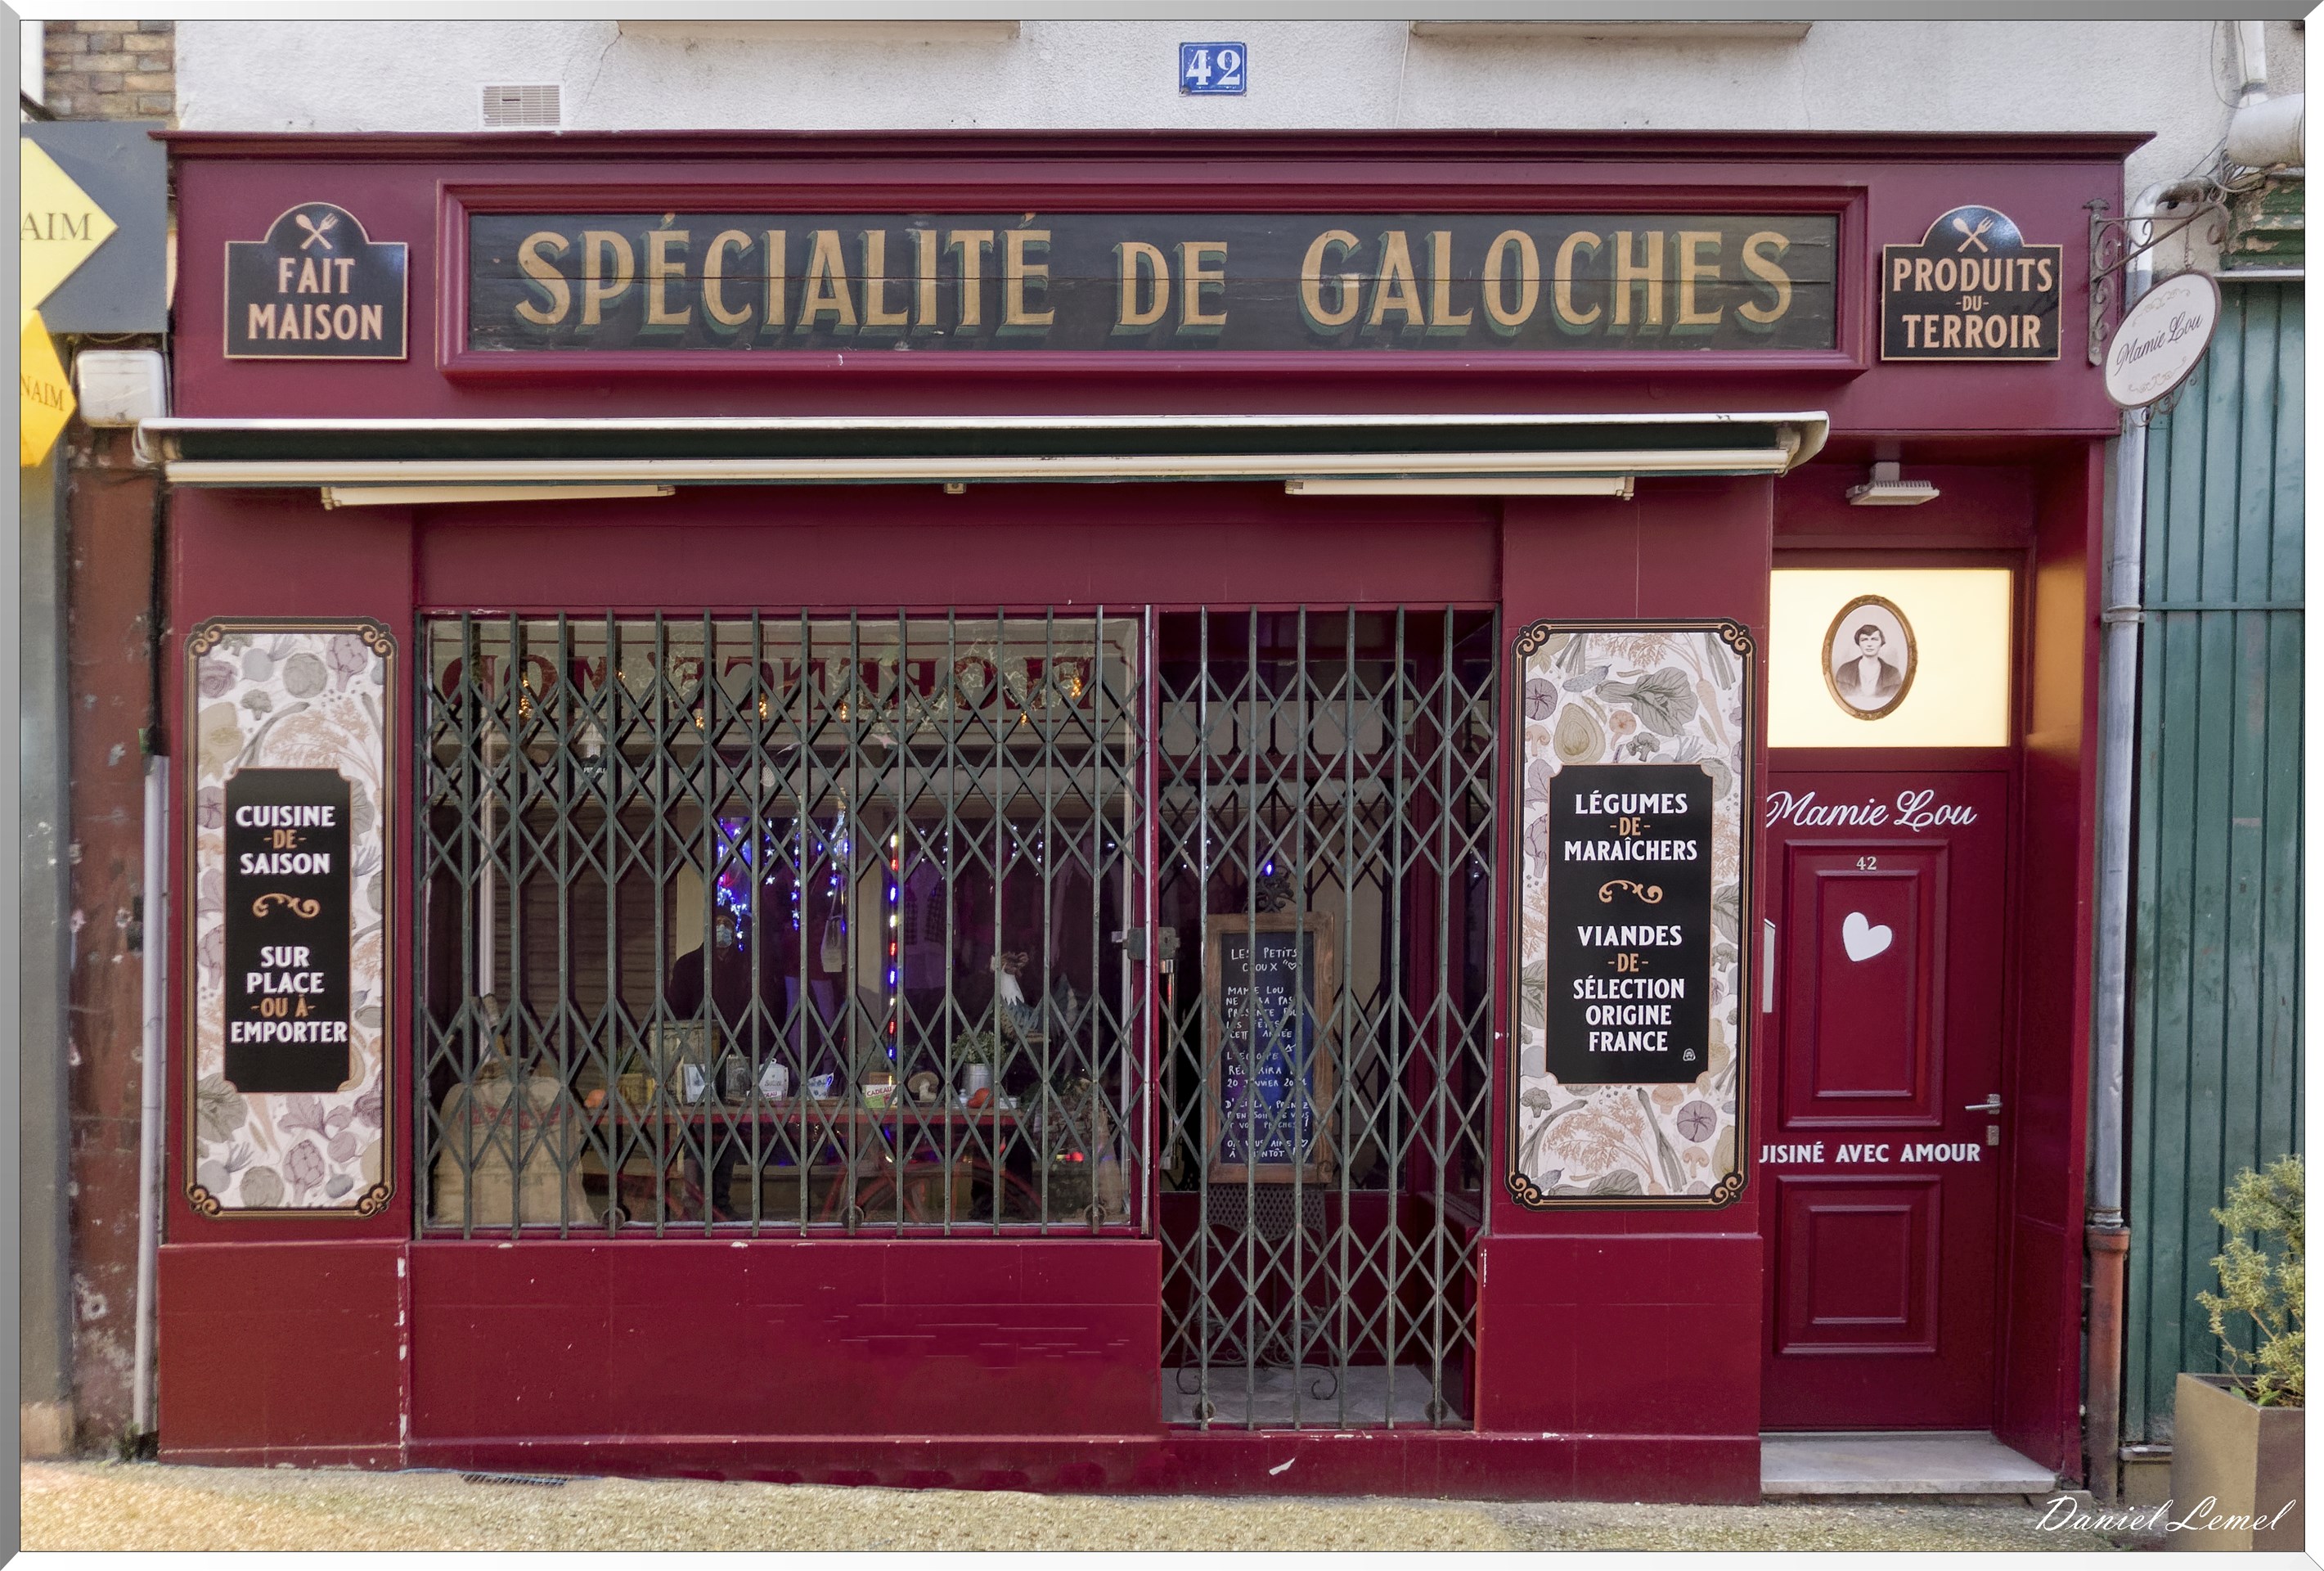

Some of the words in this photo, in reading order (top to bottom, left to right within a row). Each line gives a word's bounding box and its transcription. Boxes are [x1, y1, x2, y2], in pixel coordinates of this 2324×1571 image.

[1185, 50, 1241, 85] 42
[277, 257, 356, 295] FAIT
[515, 214, 1055, 326] SPÉCIALITÉ
[1119, 241, 1229, 326] DE
[1301, 229, 1793, 327] GALOCHES
[1892, 258, 2053, 293] PRODUITS
[247, 304, 384, 340] MAISON
[1902, 314, 2042, 349] TERROIR
[2115, 329, 2166, 376] Mamie
[2168, 311, 2204, 344] Lou
[1575, 790, 1689, 815] LÉGUMES
[1766, 790, 1890, 828] Mamie
[1895, 789, 1977, 832] Lou
[236, 805, 335, 826] CUISINE
[1563, 836, 1698, 862] MARAÎCHERS
[240, 853, 330, 875] SAISON
[1855, 856, 1877, 871] 42
[1577, 925, 1683, 946] VIANDES
[260, 946, 310, 968] SUR
[1243, 963, 1278, 972] COUX
[246, 972, 325, 993] PLACE
[1228, 986, 1260, 995] MAME
[1573, 974, 1685, 999] SÉLECTION
[1585, 1005, 1672, 1026] ORIGINE
[231, 1021, 348, 1043] EMPORTER
[1588, 1031, 1669, 1052] FRANCE
[866, 1086, 892, 1096] CADEAU
[1835, 1144, 1890, 1163] AVEC
[1899, 1143, 1981, 1163] AMOUR
